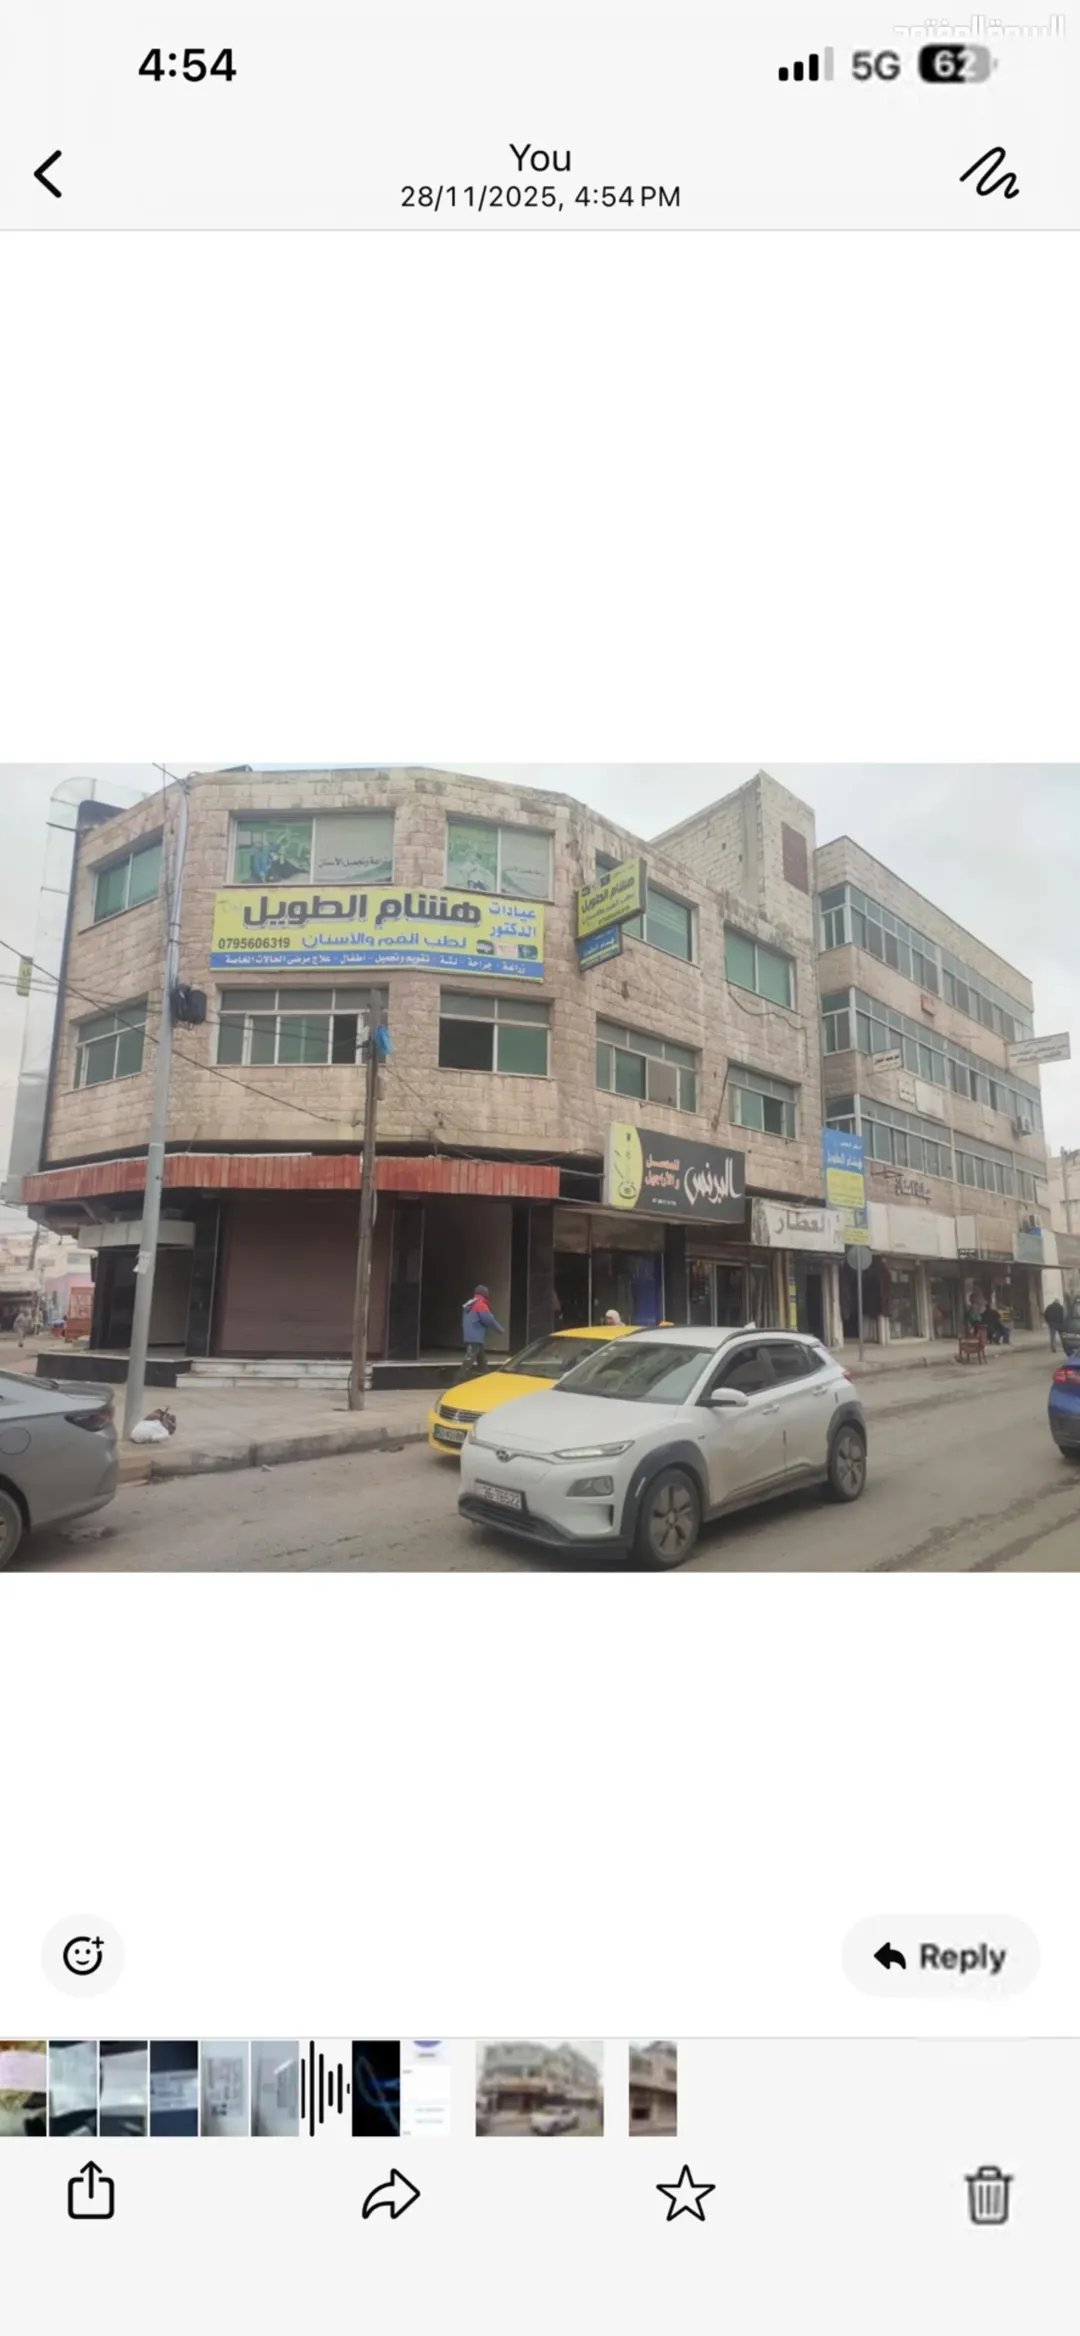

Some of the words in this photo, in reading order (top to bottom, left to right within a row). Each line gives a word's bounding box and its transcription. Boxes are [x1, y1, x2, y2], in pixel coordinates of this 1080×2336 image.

[138, 48, 237, 82] 4:54
[852, 49, 901, 80] 5G
[934, 50, 977, 78] 62
[509, 143, 571, 172] You
[401, 185, 564, 211] 28/11/2025,
[575, 185, 635, 207] 4:54
[640, 185, 680, 207] PM
[242, 893, 368, 929] الطويل
[375, 892, 482, 929] هشام
[488, 902, 537, 922] عيادات
[218, 938, 291, 950] 0795606319
[378, 931, 419, 947] الفم
[424, 933, 466, 948] لطب
[488, 922, 537, 939] الدكتور
[684, 1156, 742, 1206] البرنس
[919, 1942, 1006, 1977] Reply
